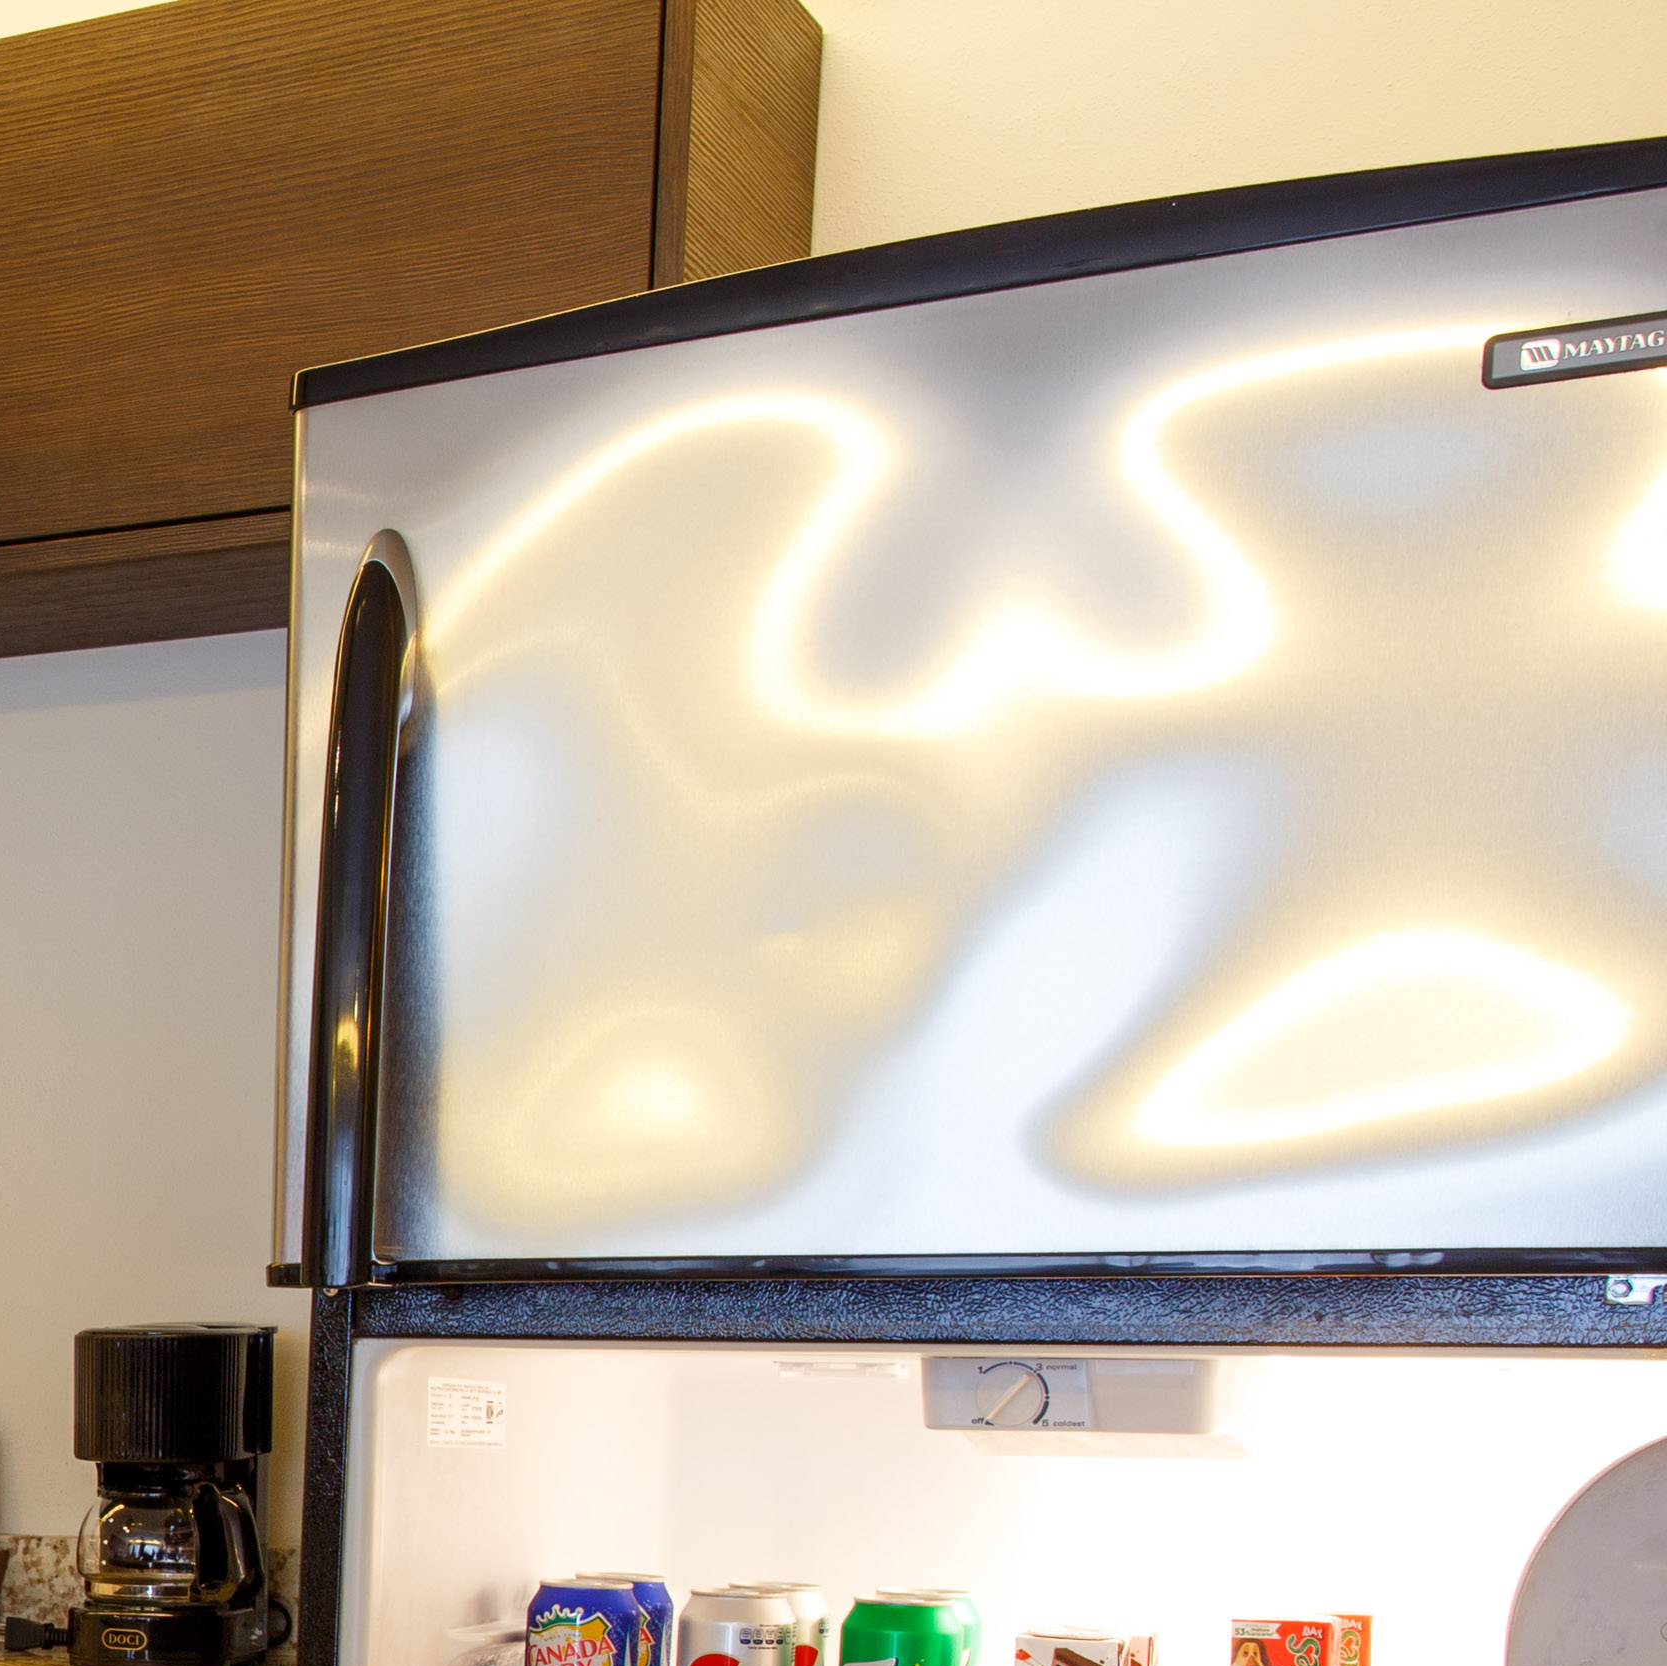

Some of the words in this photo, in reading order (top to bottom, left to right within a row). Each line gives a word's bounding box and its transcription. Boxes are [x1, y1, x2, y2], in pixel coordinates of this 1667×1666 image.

[1563, 330, 1665, 359] MAYTAG
[978, 1366, 984, 1374] 1
[1035, 1363, 1043, 1371] 3
[108, 1633, 140, 1645] DOCI
